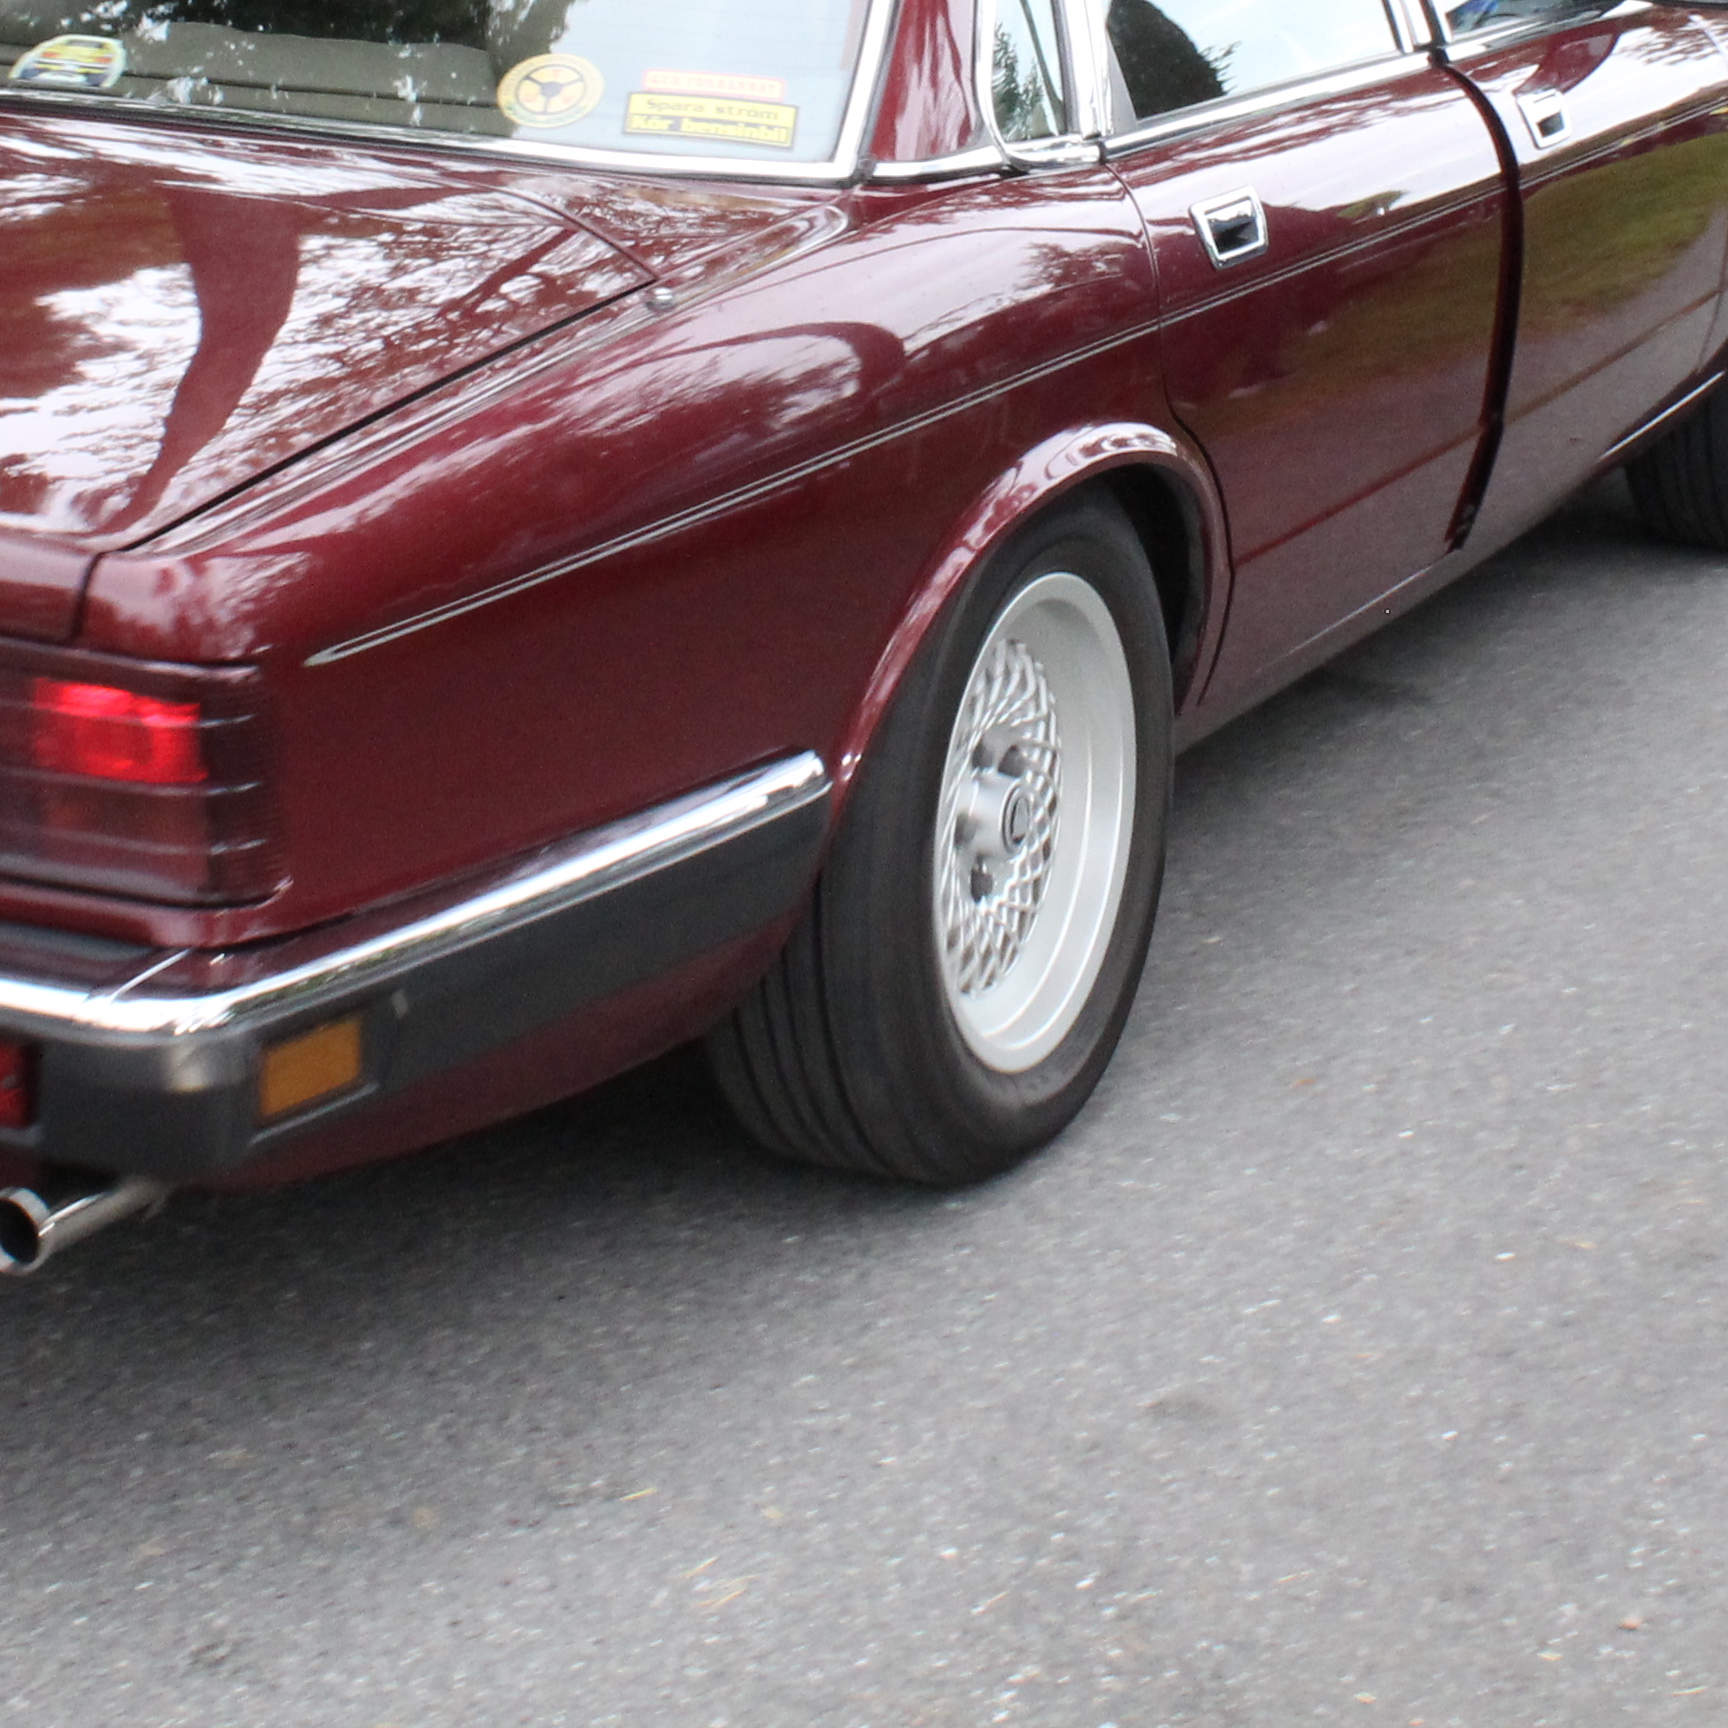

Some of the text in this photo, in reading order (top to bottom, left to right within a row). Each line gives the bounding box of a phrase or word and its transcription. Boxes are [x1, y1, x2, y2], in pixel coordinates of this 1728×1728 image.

[647, 98, 778, 121] Spara ström
[631, 115, 788, 143] Kör bensinbil
